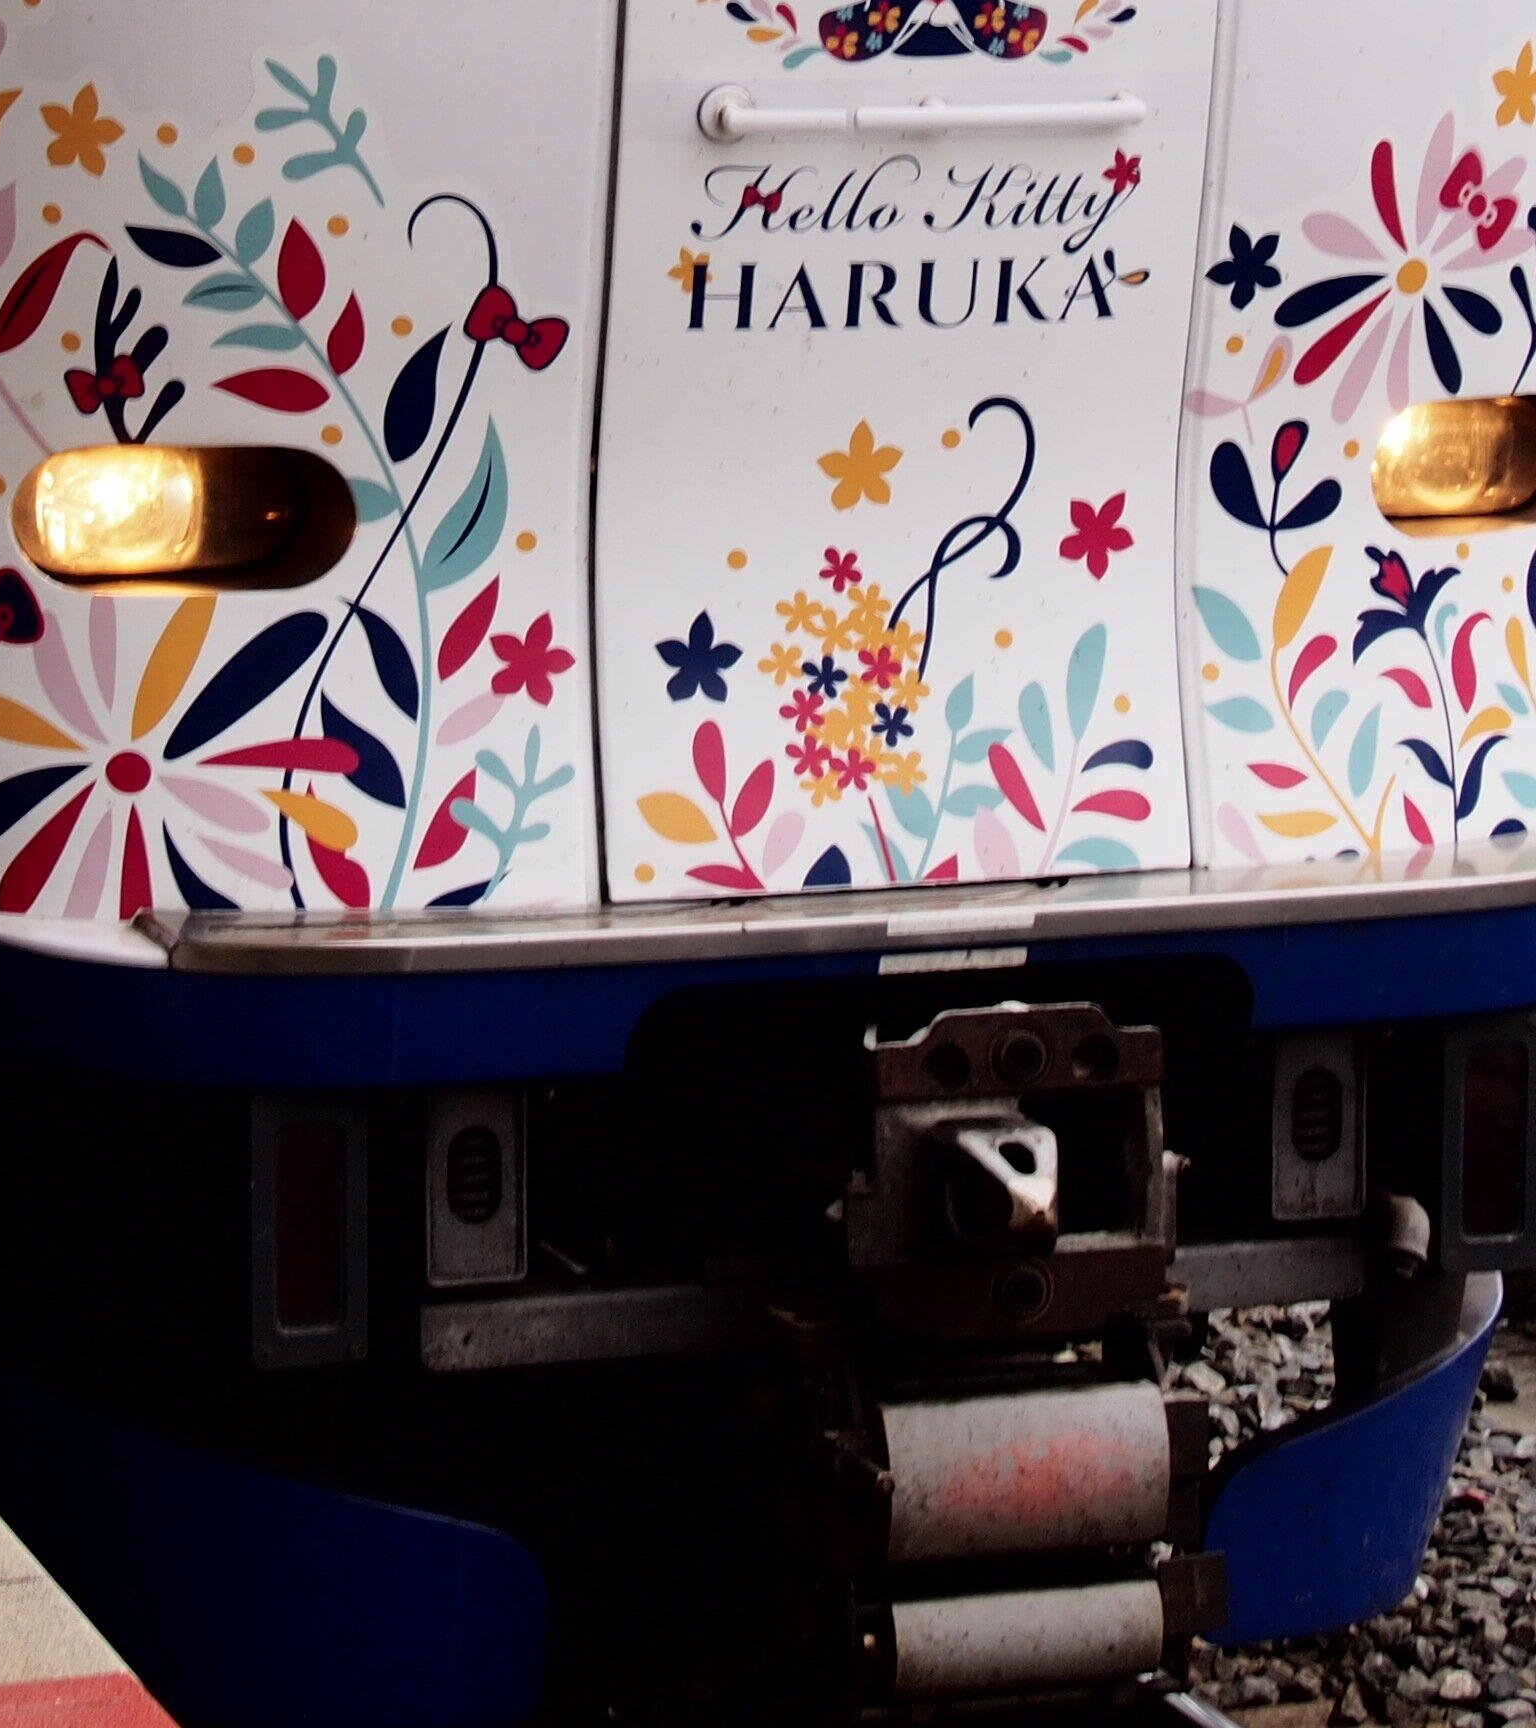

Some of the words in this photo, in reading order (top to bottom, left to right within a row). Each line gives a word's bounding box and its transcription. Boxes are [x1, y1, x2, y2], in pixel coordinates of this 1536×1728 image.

[690, 154, 921, 241] Hello
[923, 161, 1141, 255] Kitty
[685, 256, 1116, 332] HARUKA
